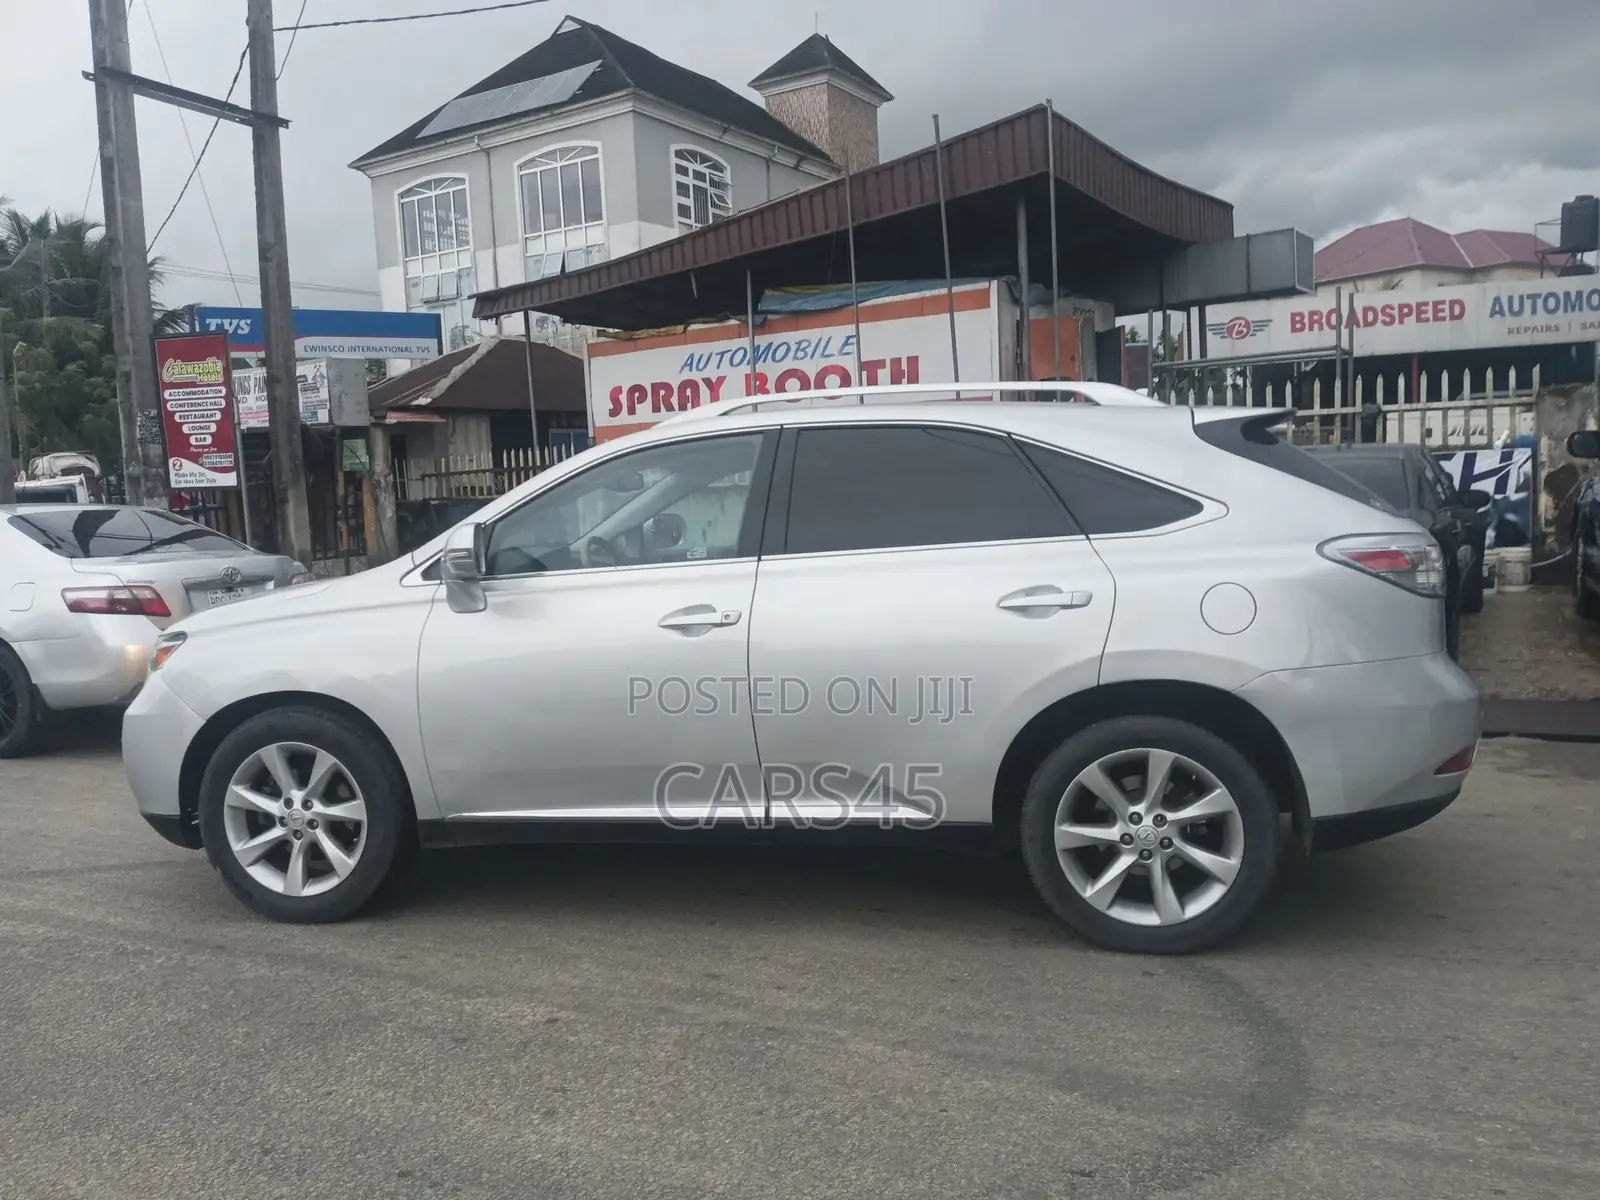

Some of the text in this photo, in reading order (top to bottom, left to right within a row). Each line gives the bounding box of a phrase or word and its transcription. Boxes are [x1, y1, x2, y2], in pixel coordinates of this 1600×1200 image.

[1290, 298, 1466, 334] BROADSPEED
[206, 318, 251, 334] TVS
[1507, 323, 1560, 336] REPAIRS
[303, 344, 431, 354] EWINSCO INTERNATIONAL TVS
[679, 334, 857, 374] AUTOMOBILE
[197, 372, 223, 383] Hotels
[608, 355, 919, 418] SPRAY BOOTH
[168, 388, 223, 398] ACCOMMODATION
[170, 399, 223, 409] CONFERENCE HALL
[178, 412, 217, 420] RESTAURANT
[188, 424, 212, 432] LOUNGE
